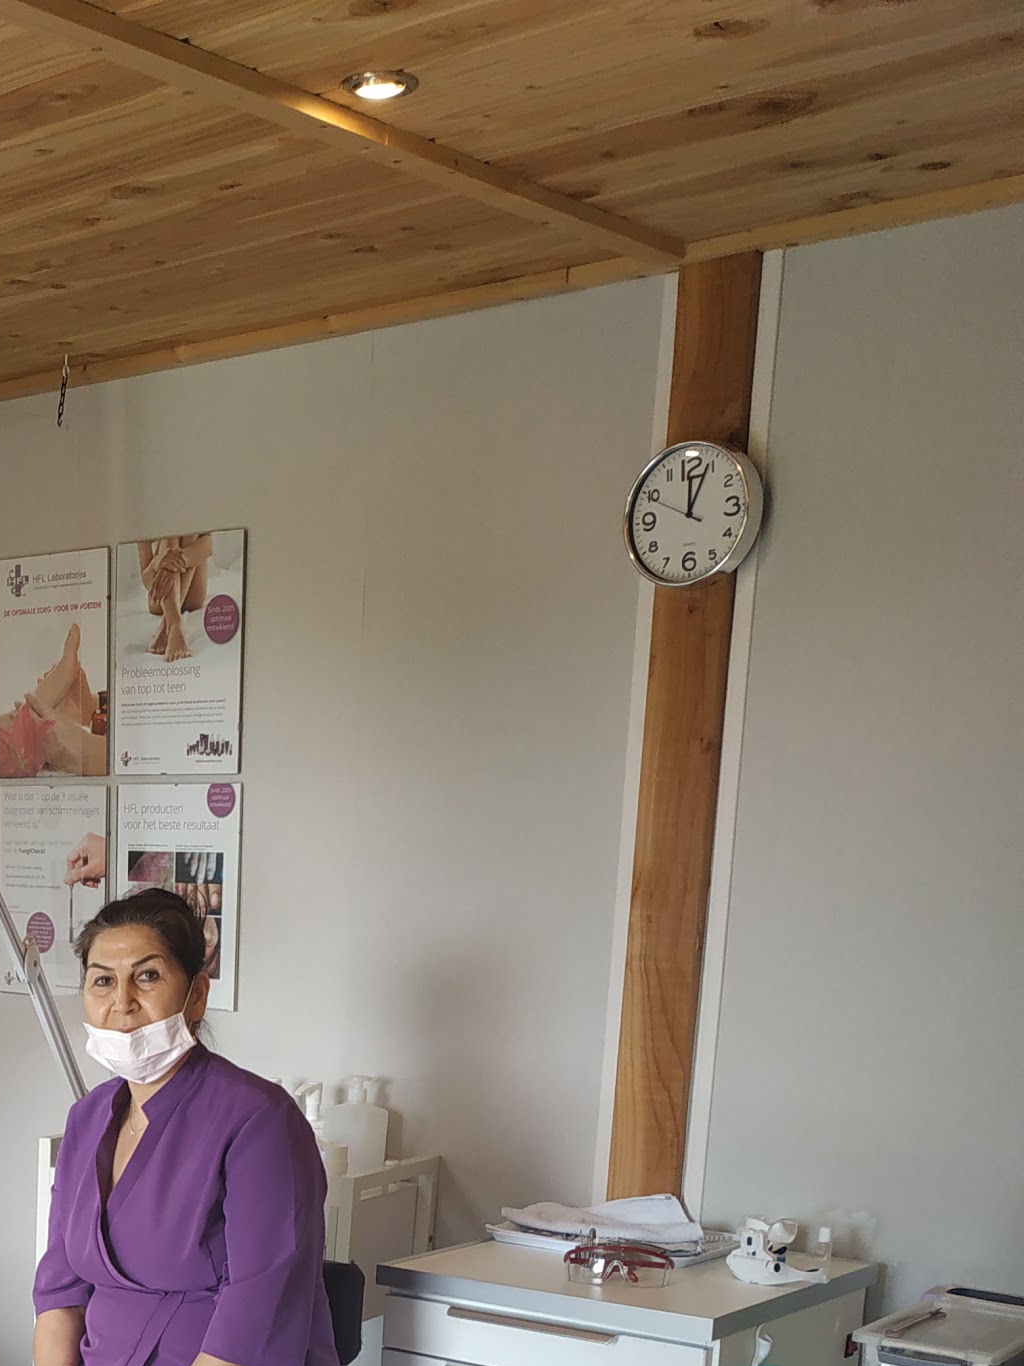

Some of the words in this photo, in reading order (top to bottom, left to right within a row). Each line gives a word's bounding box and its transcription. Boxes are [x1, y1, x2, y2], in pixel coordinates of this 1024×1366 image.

[681, 456, 703, 482] 12
[711, 459, 716, 473] 1
[666, 468, 674, 482] 11
[723, 473, 734, 488] 2
[647, 488, 661, 503] 10
[723, 495, 741, 517] 3
[642, 511, 657, 532] 9
[722, 526, 732, 538] 4
[648, 541, 659, 553] 8
[708, 548, 717, 561] 5
[662, 556, 671, 569] 7
[681, 551, 697, 572] 6
[32, 575, 46, 583] HFL
[48, 571, 87, 582] Laboratories
[4, 609, 11, 617] DE
[12, 607, 36, 616] OPTIMALE
[36, 606, 52, 614] ZORG
[53, 604, 69, 613] VOOR
[121, 665, 201, 679] Probleemoplossing
[121, 686, 136, 695] van
[137, 685, 151, 696] top
[153, 683, 166, 693] tot
[167, 683, 186, 693] teen
[24, 792, 34, 801] dat
[41, 793, 50, 803] op
[51, 792, 60, 801] de
[61, 792, 66, 801] 3
[123, 804, 139, 814] HFL
[141, 803, 184, 816] producten
[123, 820, 141, 830] voor
[143, 819, 156, 830] het
[158, 819, 182, 830] beste
[183, 819, 220, 831] resultaat
